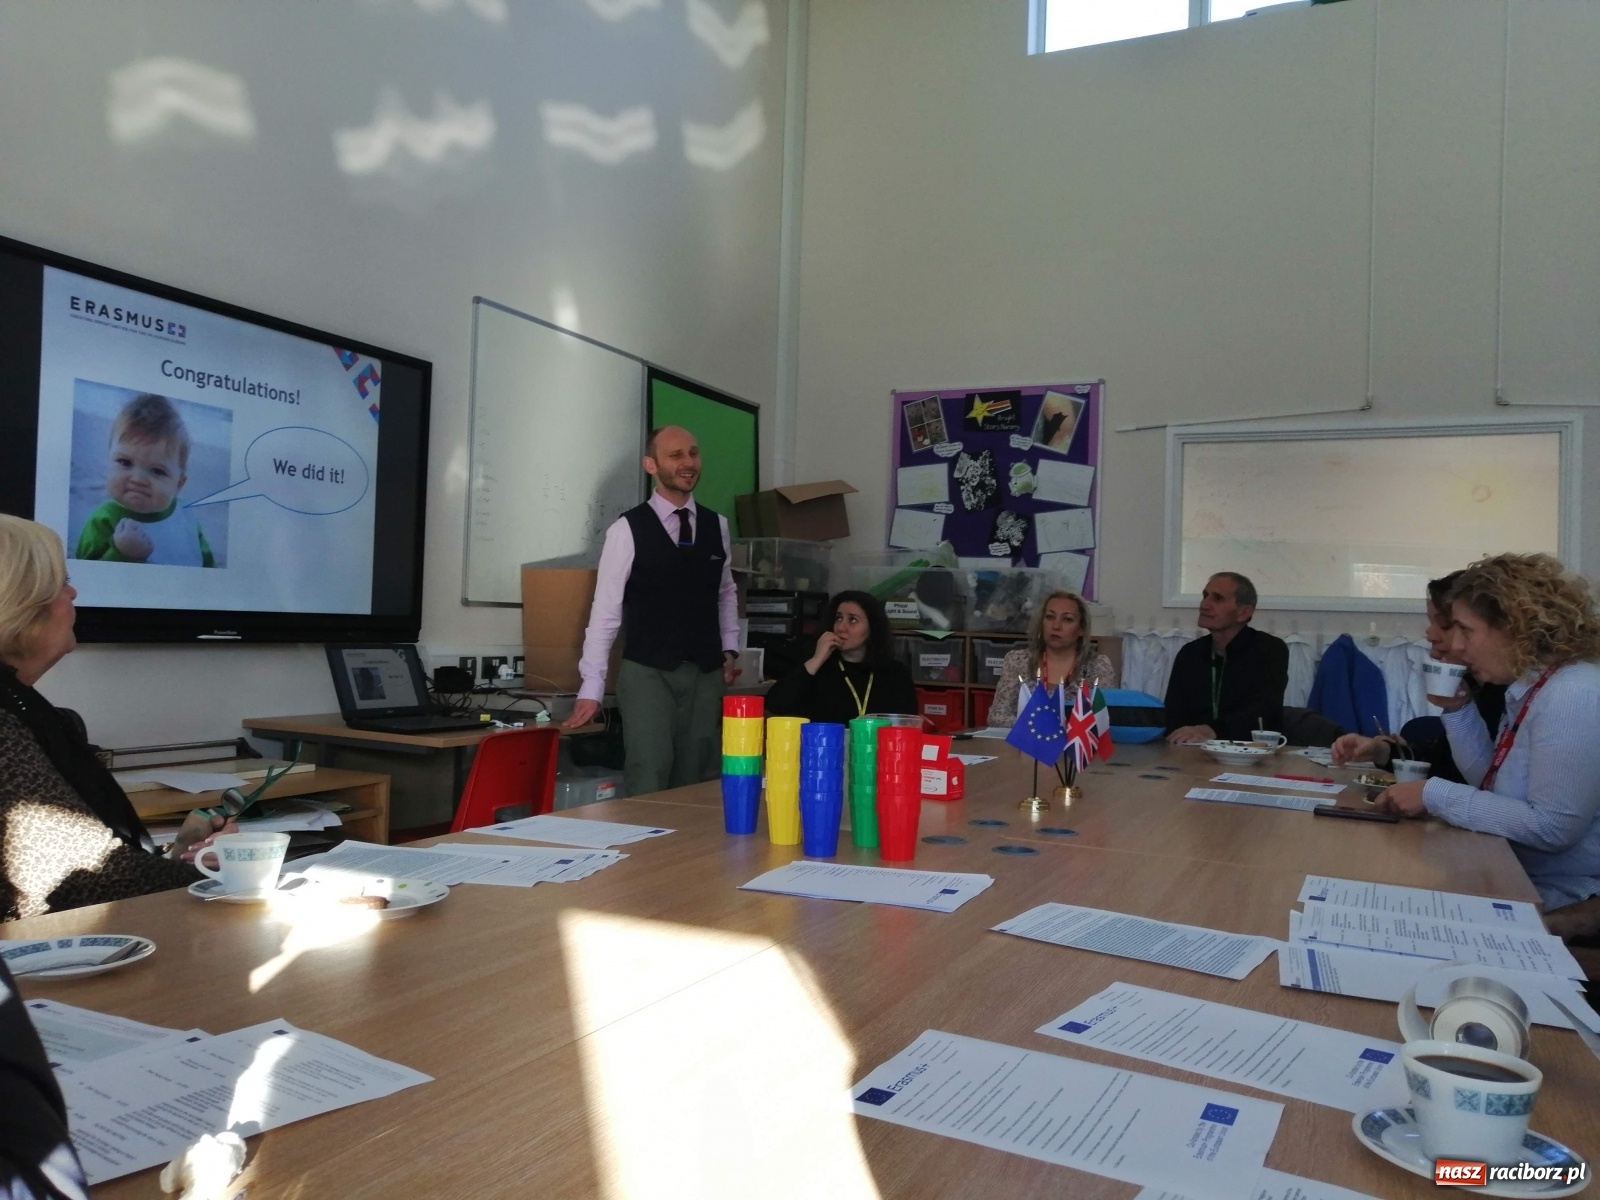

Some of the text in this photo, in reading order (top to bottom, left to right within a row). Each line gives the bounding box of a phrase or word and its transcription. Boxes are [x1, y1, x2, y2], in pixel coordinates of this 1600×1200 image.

[70, 295, 164, 332] ERASMUS
[161, 359, 300, 405] Congratulations!
[273, 458, 345, 484] We did it!
[886, 1063, 931, 1092] Erasmus+
